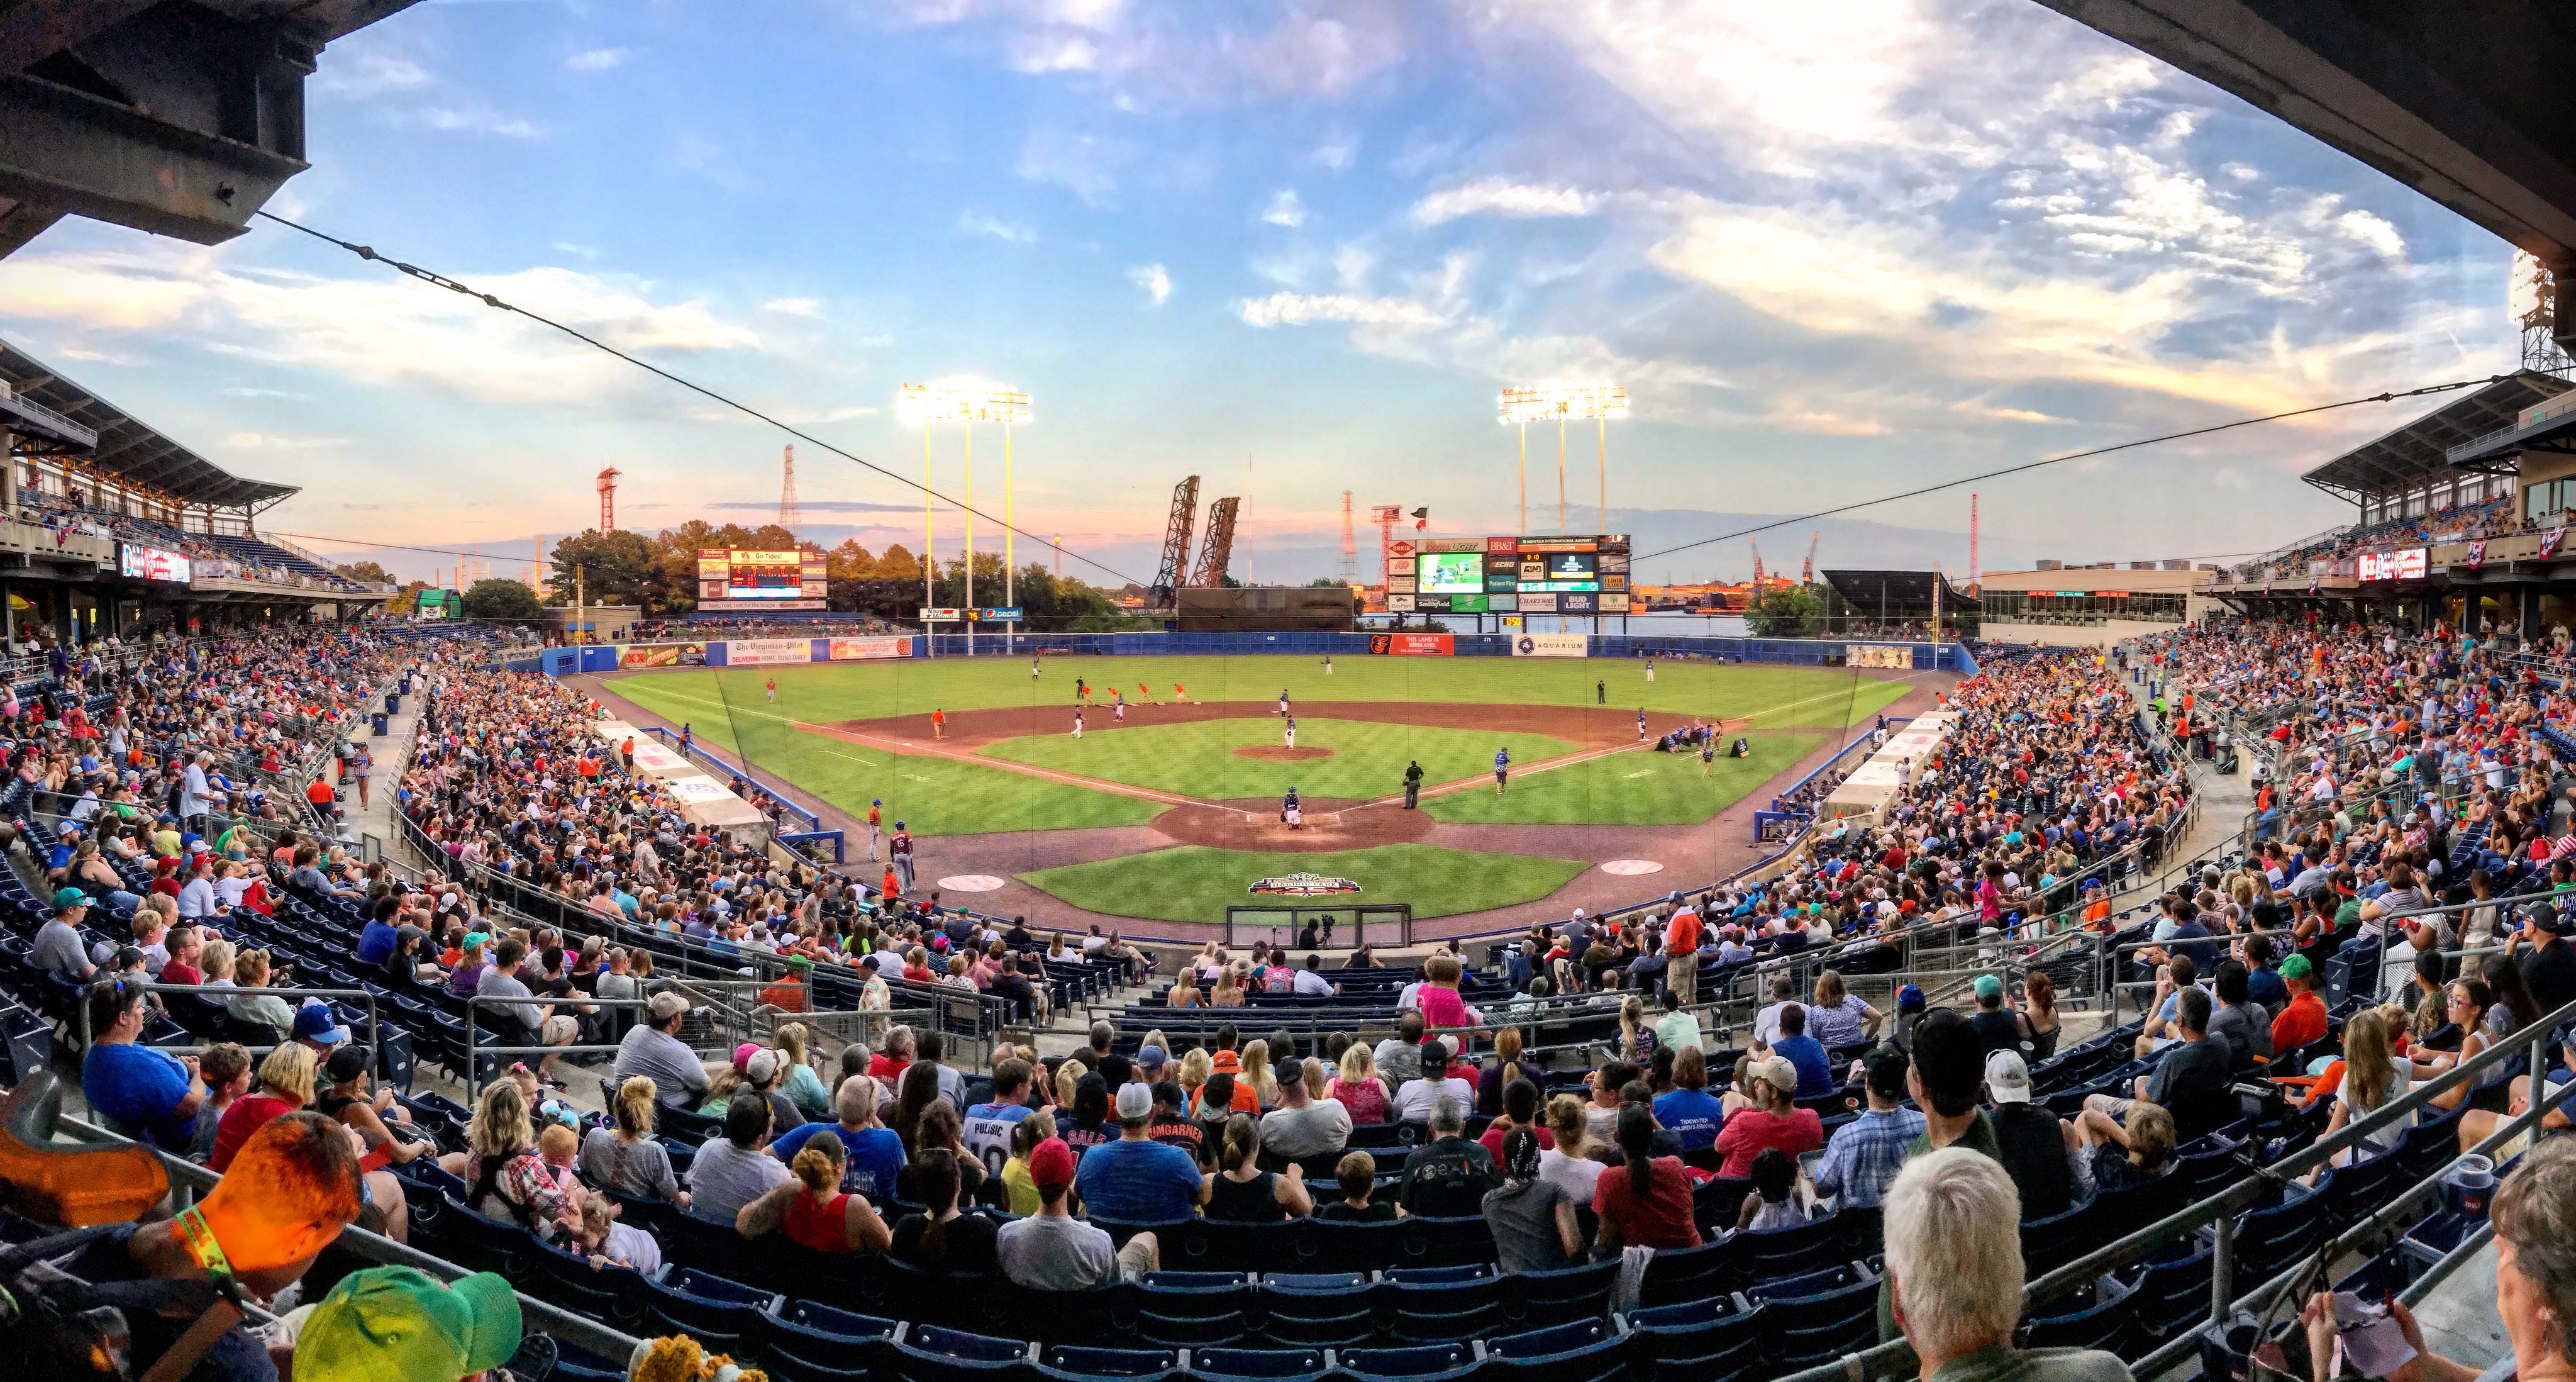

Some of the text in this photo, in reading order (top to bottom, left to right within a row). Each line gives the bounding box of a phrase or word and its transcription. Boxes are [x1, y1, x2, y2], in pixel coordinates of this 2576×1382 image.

[1449, 543, 1478, 551] LIGHT
[1490, 542, 1514, 550] BB&T
[1394, 561, 1410, 569] ADP
[969, 612, 978, 620] 75
[997, 610, 1019, 618] pepsi
[1507, 617, 1521, 626] 0:50
[736, 642, 803, 651] The Virginian-Pilot
[627, 652, 646, 664] XX
[646, 646, 679, 666] CANTINA
[679, 652, 702, 660] Corona
[896, 839, 905, 847] 16
[881, 1074, 894, 1084] 2012
[975, 1123, 1003, 1137] PULISIC
[1148, 1123, 1203, 1144] UMGARNER
[1068, 1130, 1107, 1147] SALE
[970, 1141, 1008, 1176] 10
